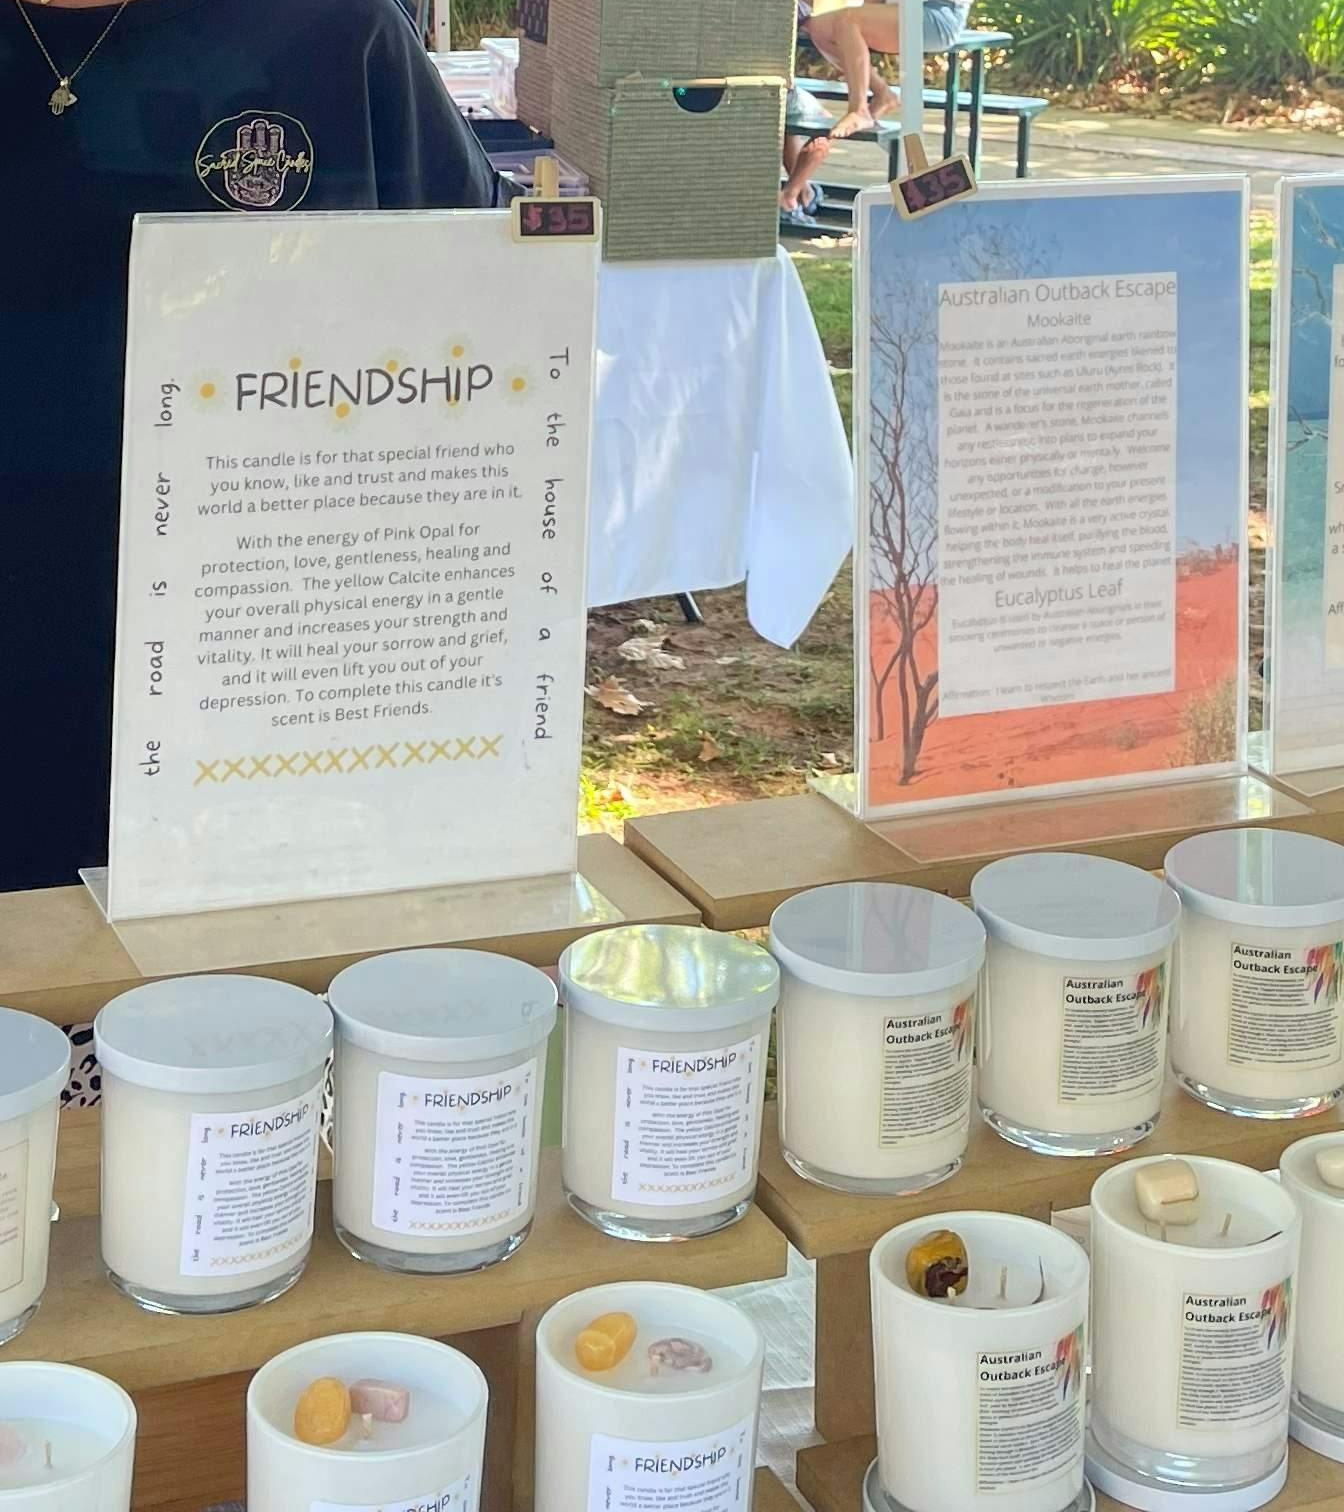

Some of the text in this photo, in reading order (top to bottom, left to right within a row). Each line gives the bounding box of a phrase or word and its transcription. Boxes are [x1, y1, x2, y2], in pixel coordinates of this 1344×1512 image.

[523, 203, 589, 232] $35
[939, 279, 1176, 307] Australian Outback Escape
[1026, 312, 1092, 329] Mookaite
[236, 364, 493, 411] FRIENDSHIP
[205, 442, 515, 471] This candle is for that special friend who
[209, 463, 509, 497] you know, like and trust and makes this
[197, 485, 523, 516] world a better place because they are in it.
[236, 522, 481, 551] With the energy of Pink Opal for
[534, 347, 569, 739] To the house of a friend
[139, 378, 181, 776] the road is never long.
[994, 576, 1125, 609] Eucalyptus Leaf
[1233, 945, 1292, 959] Australian
[1233, 959, 1318, 977] Outback Escape
[1065, 979, 1124, 989] Australian
[1065, 993, 1113, 1005] Outback
[886, 1014, 942, 1029] Australian
[886, 1030, 933, 1045] Outback
[652, 1051, 737, 1073] FRIENDSHIP
[424, 1084, 512, 1108] FRIENDSHIP
[230, 1103, 309, 1138] FRIENDSHIP
[1185, 1295, 1247, 1307] Australian
[1185, 1311, 1236, 1324] Outback
[979, 1351, 1042, 1365] Australian
[980, 1367, 1032, 1381] Outback
[634, 1446, 727, 1473] FRIENDSHIP
